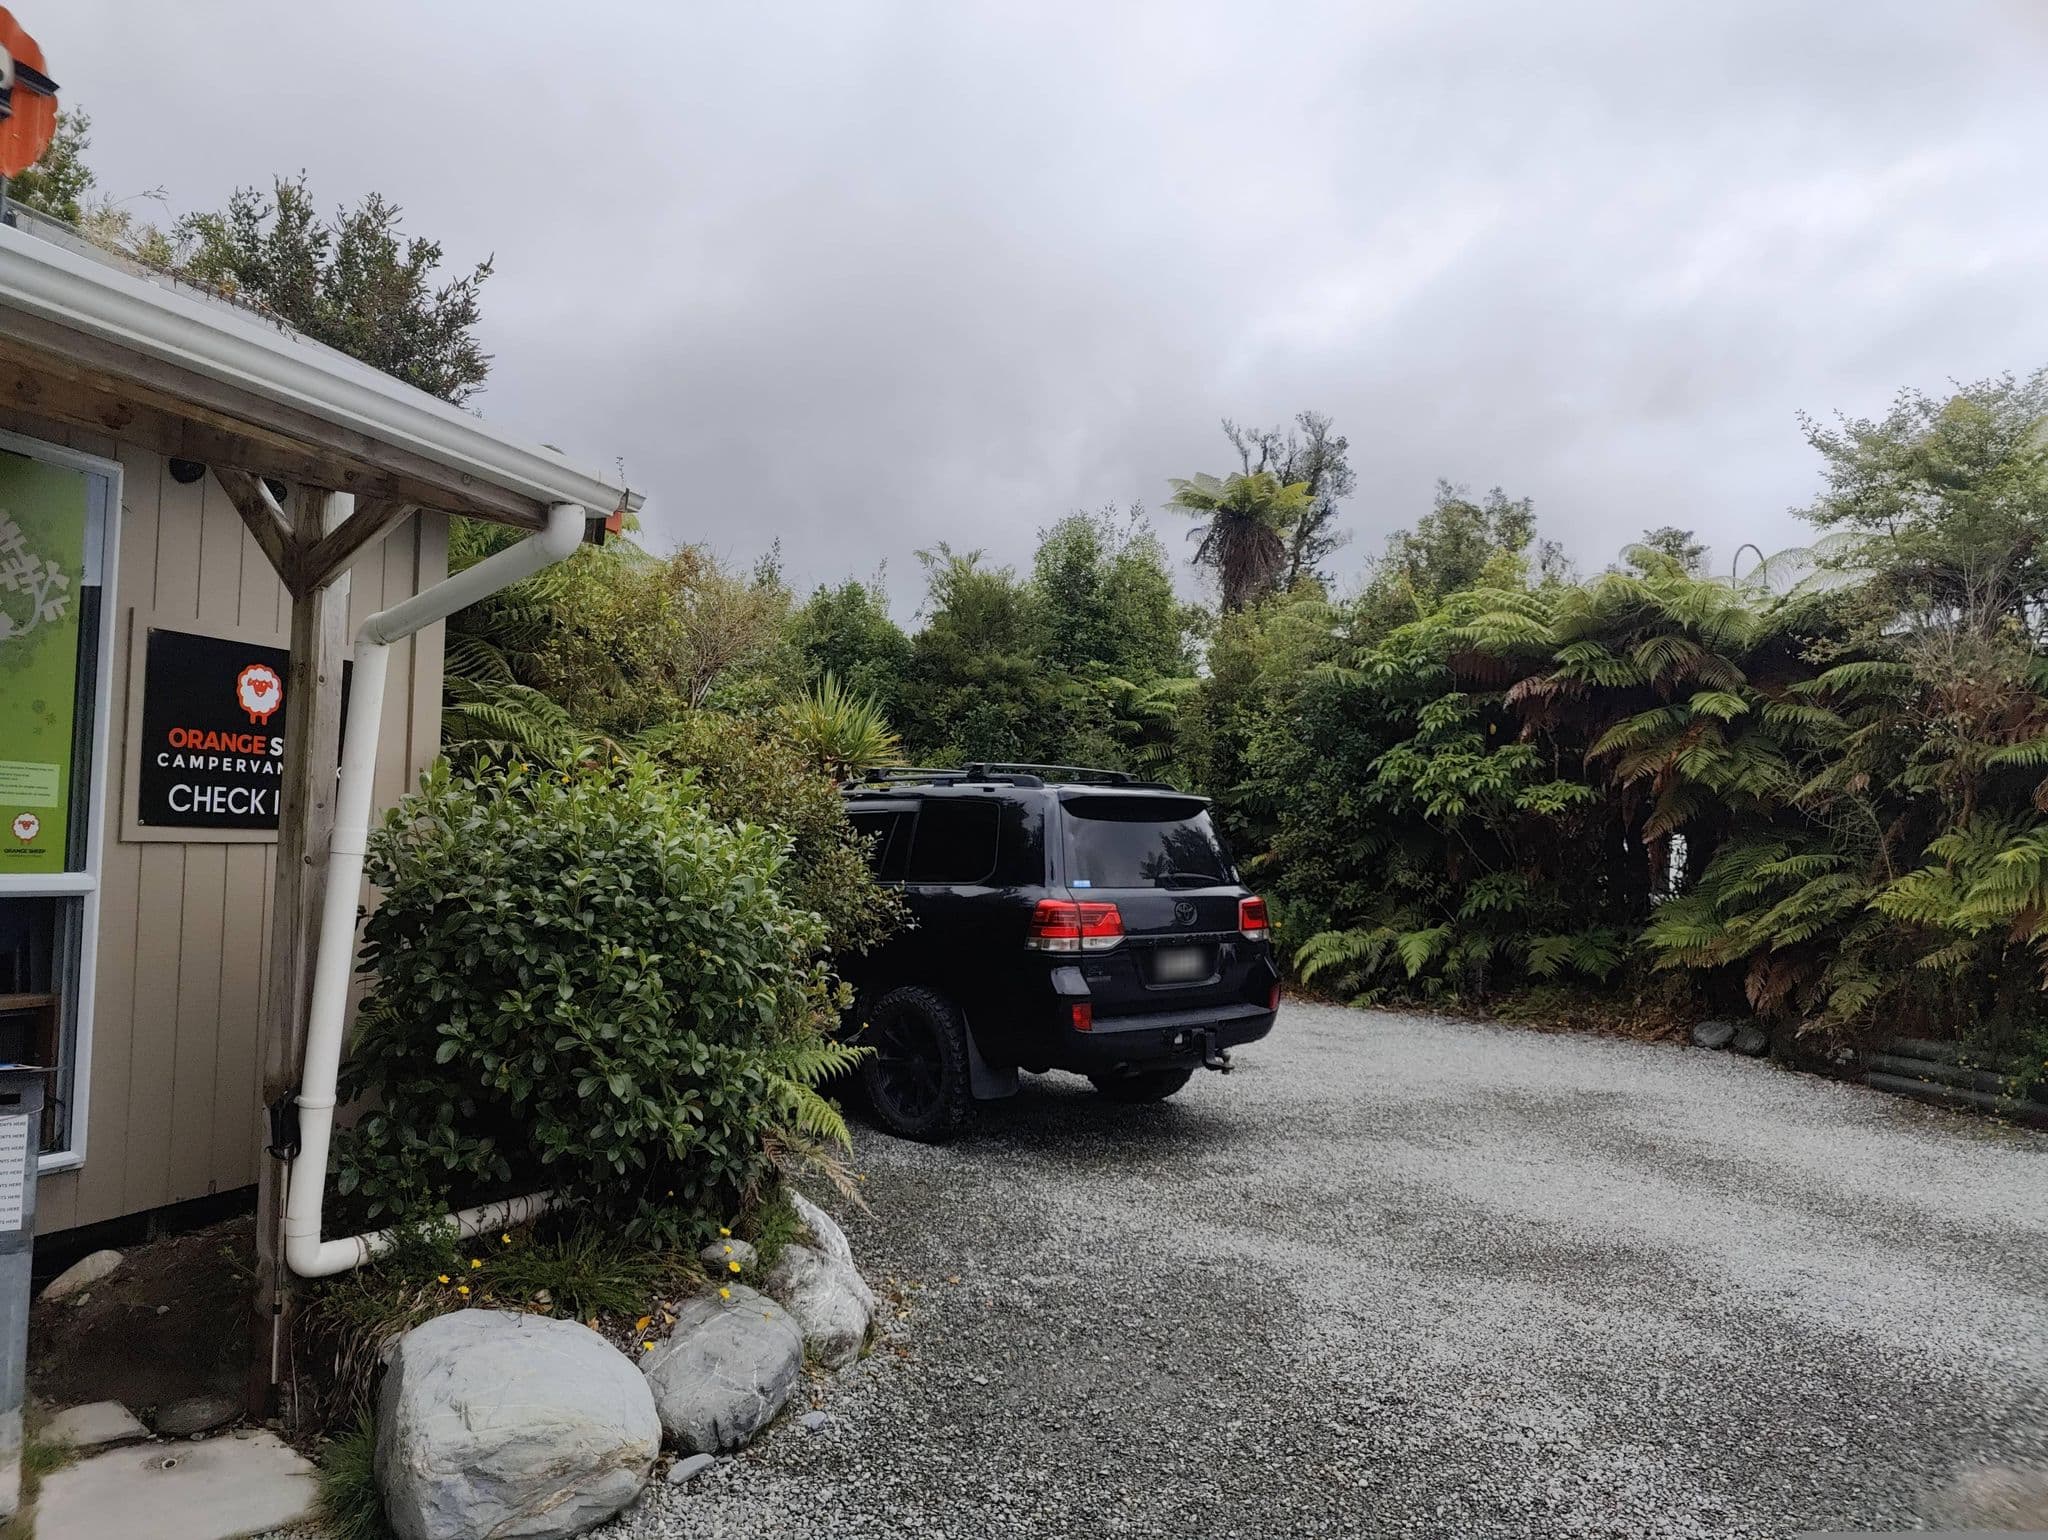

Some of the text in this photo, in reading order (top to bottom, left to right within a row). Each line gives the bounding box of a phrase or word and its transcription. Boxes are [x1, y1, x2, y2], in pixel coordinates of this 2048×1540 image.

[168, 728, 283, 756] ORANGE S
[168, 784, 280, 816] CHECK I
